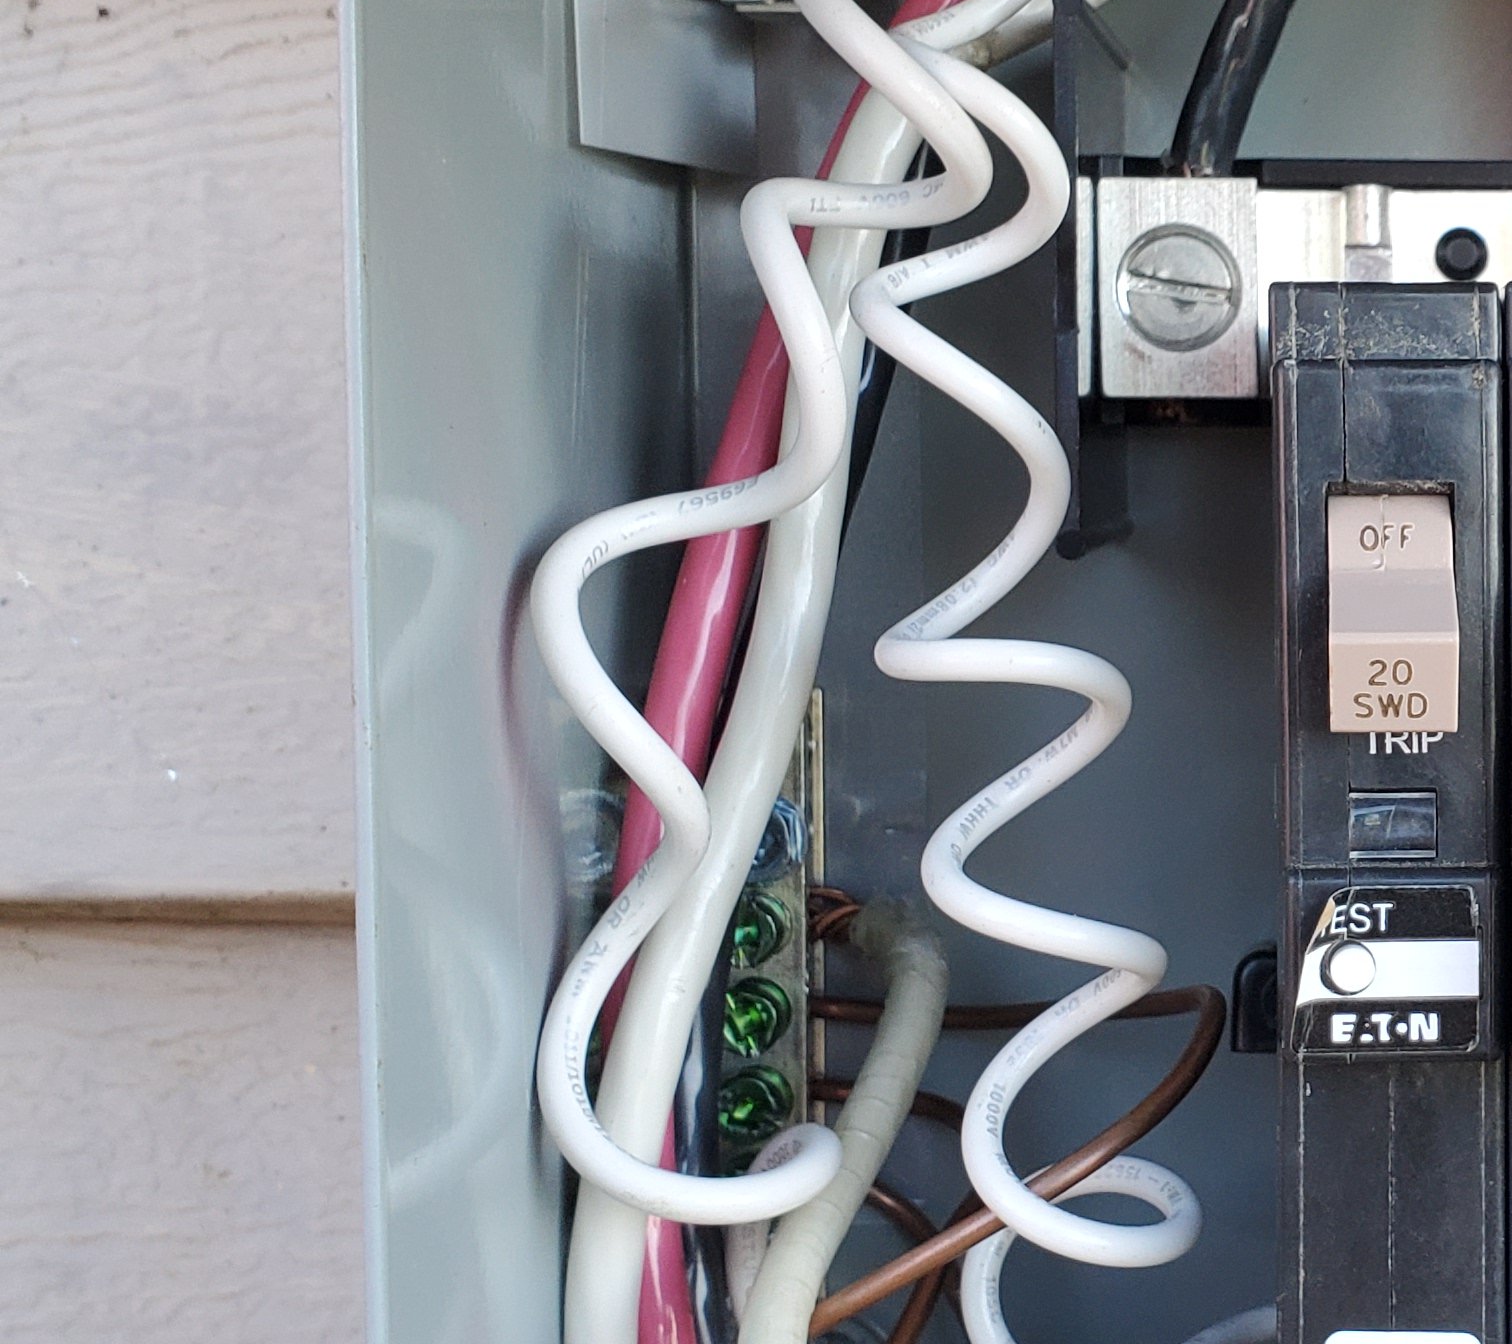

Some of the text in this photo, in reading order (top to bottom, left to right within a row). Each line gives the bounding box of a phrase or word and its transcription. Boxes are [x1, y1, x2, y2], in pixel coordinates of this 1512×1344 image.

[1358, 524, 1415, 552] OFF
[1367, 659, 1414, 688] 20
[1352, 692, 1429, 719] SWD
[1321, 902, 1395, 938] EST
